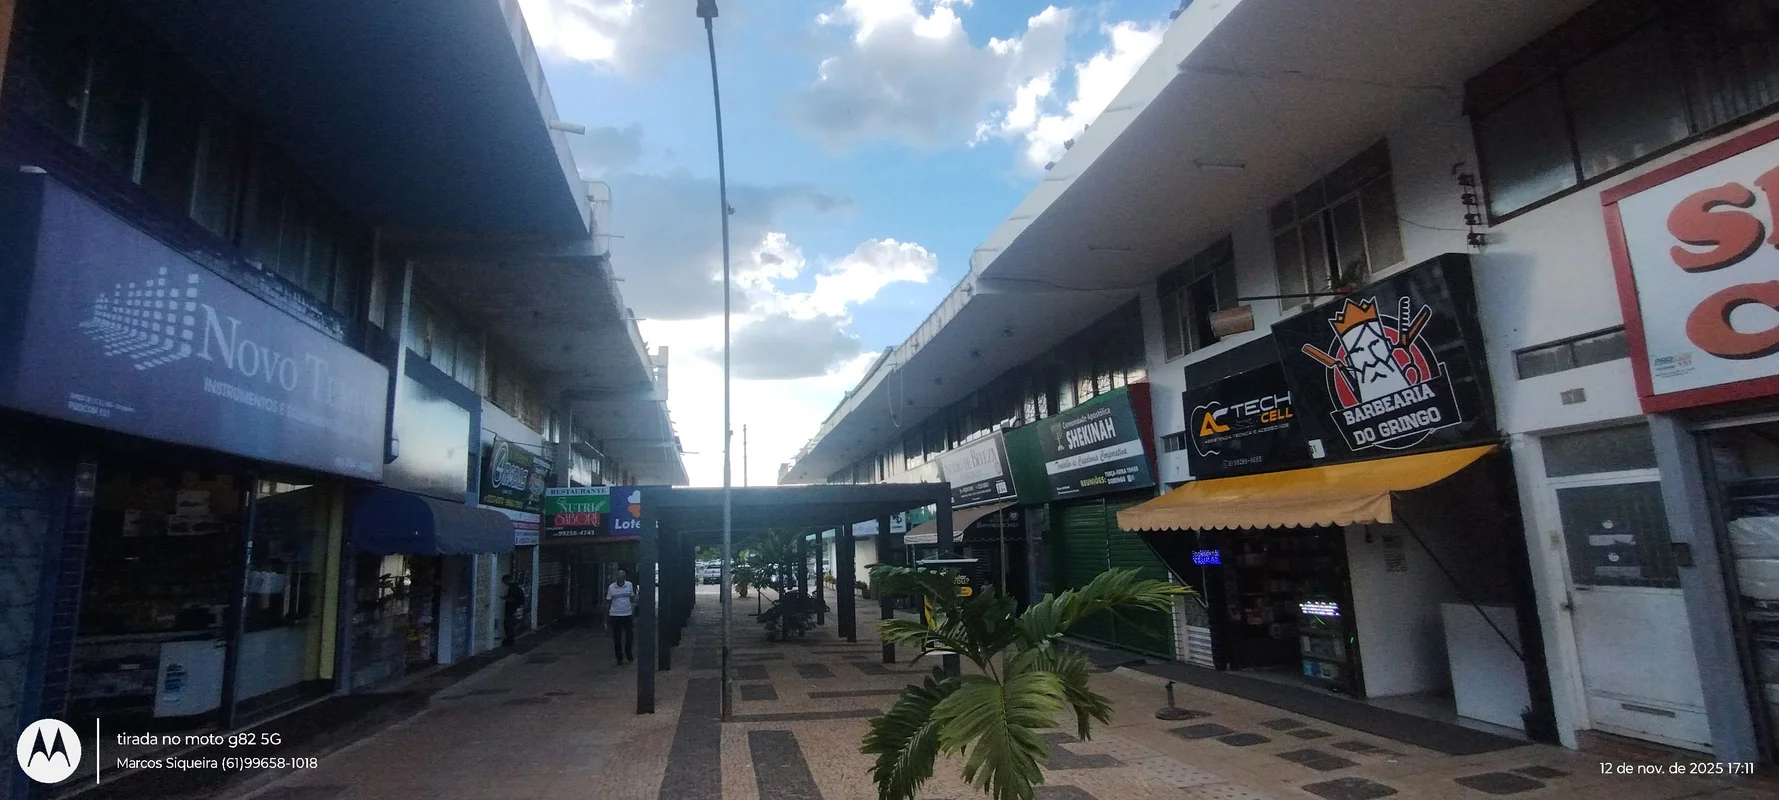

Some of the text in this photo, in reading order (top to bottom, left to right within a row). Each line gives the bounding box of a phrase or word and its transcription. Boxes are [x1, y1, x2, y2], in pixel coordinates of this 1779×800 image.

[204, 376, 278, 414] INSTRUMENTOS
[1343, 382, 1435, 426] BARBEARIA
[1062, 416, 1087, 430] Comunidade
[1199, 390, 1292, 437] AC TECH
[1261, 407, 1294, 423] CELL
[1353, 406, 1441, 445] DO GRINGO
[1066, 417, 1117, 450] SHEKINAH
[550, 487, 607, 496] RESTAURANTE
[1080, 475, 1107, 487] REUNIÕES:
[560, 502, 595, 513] NUTRI
